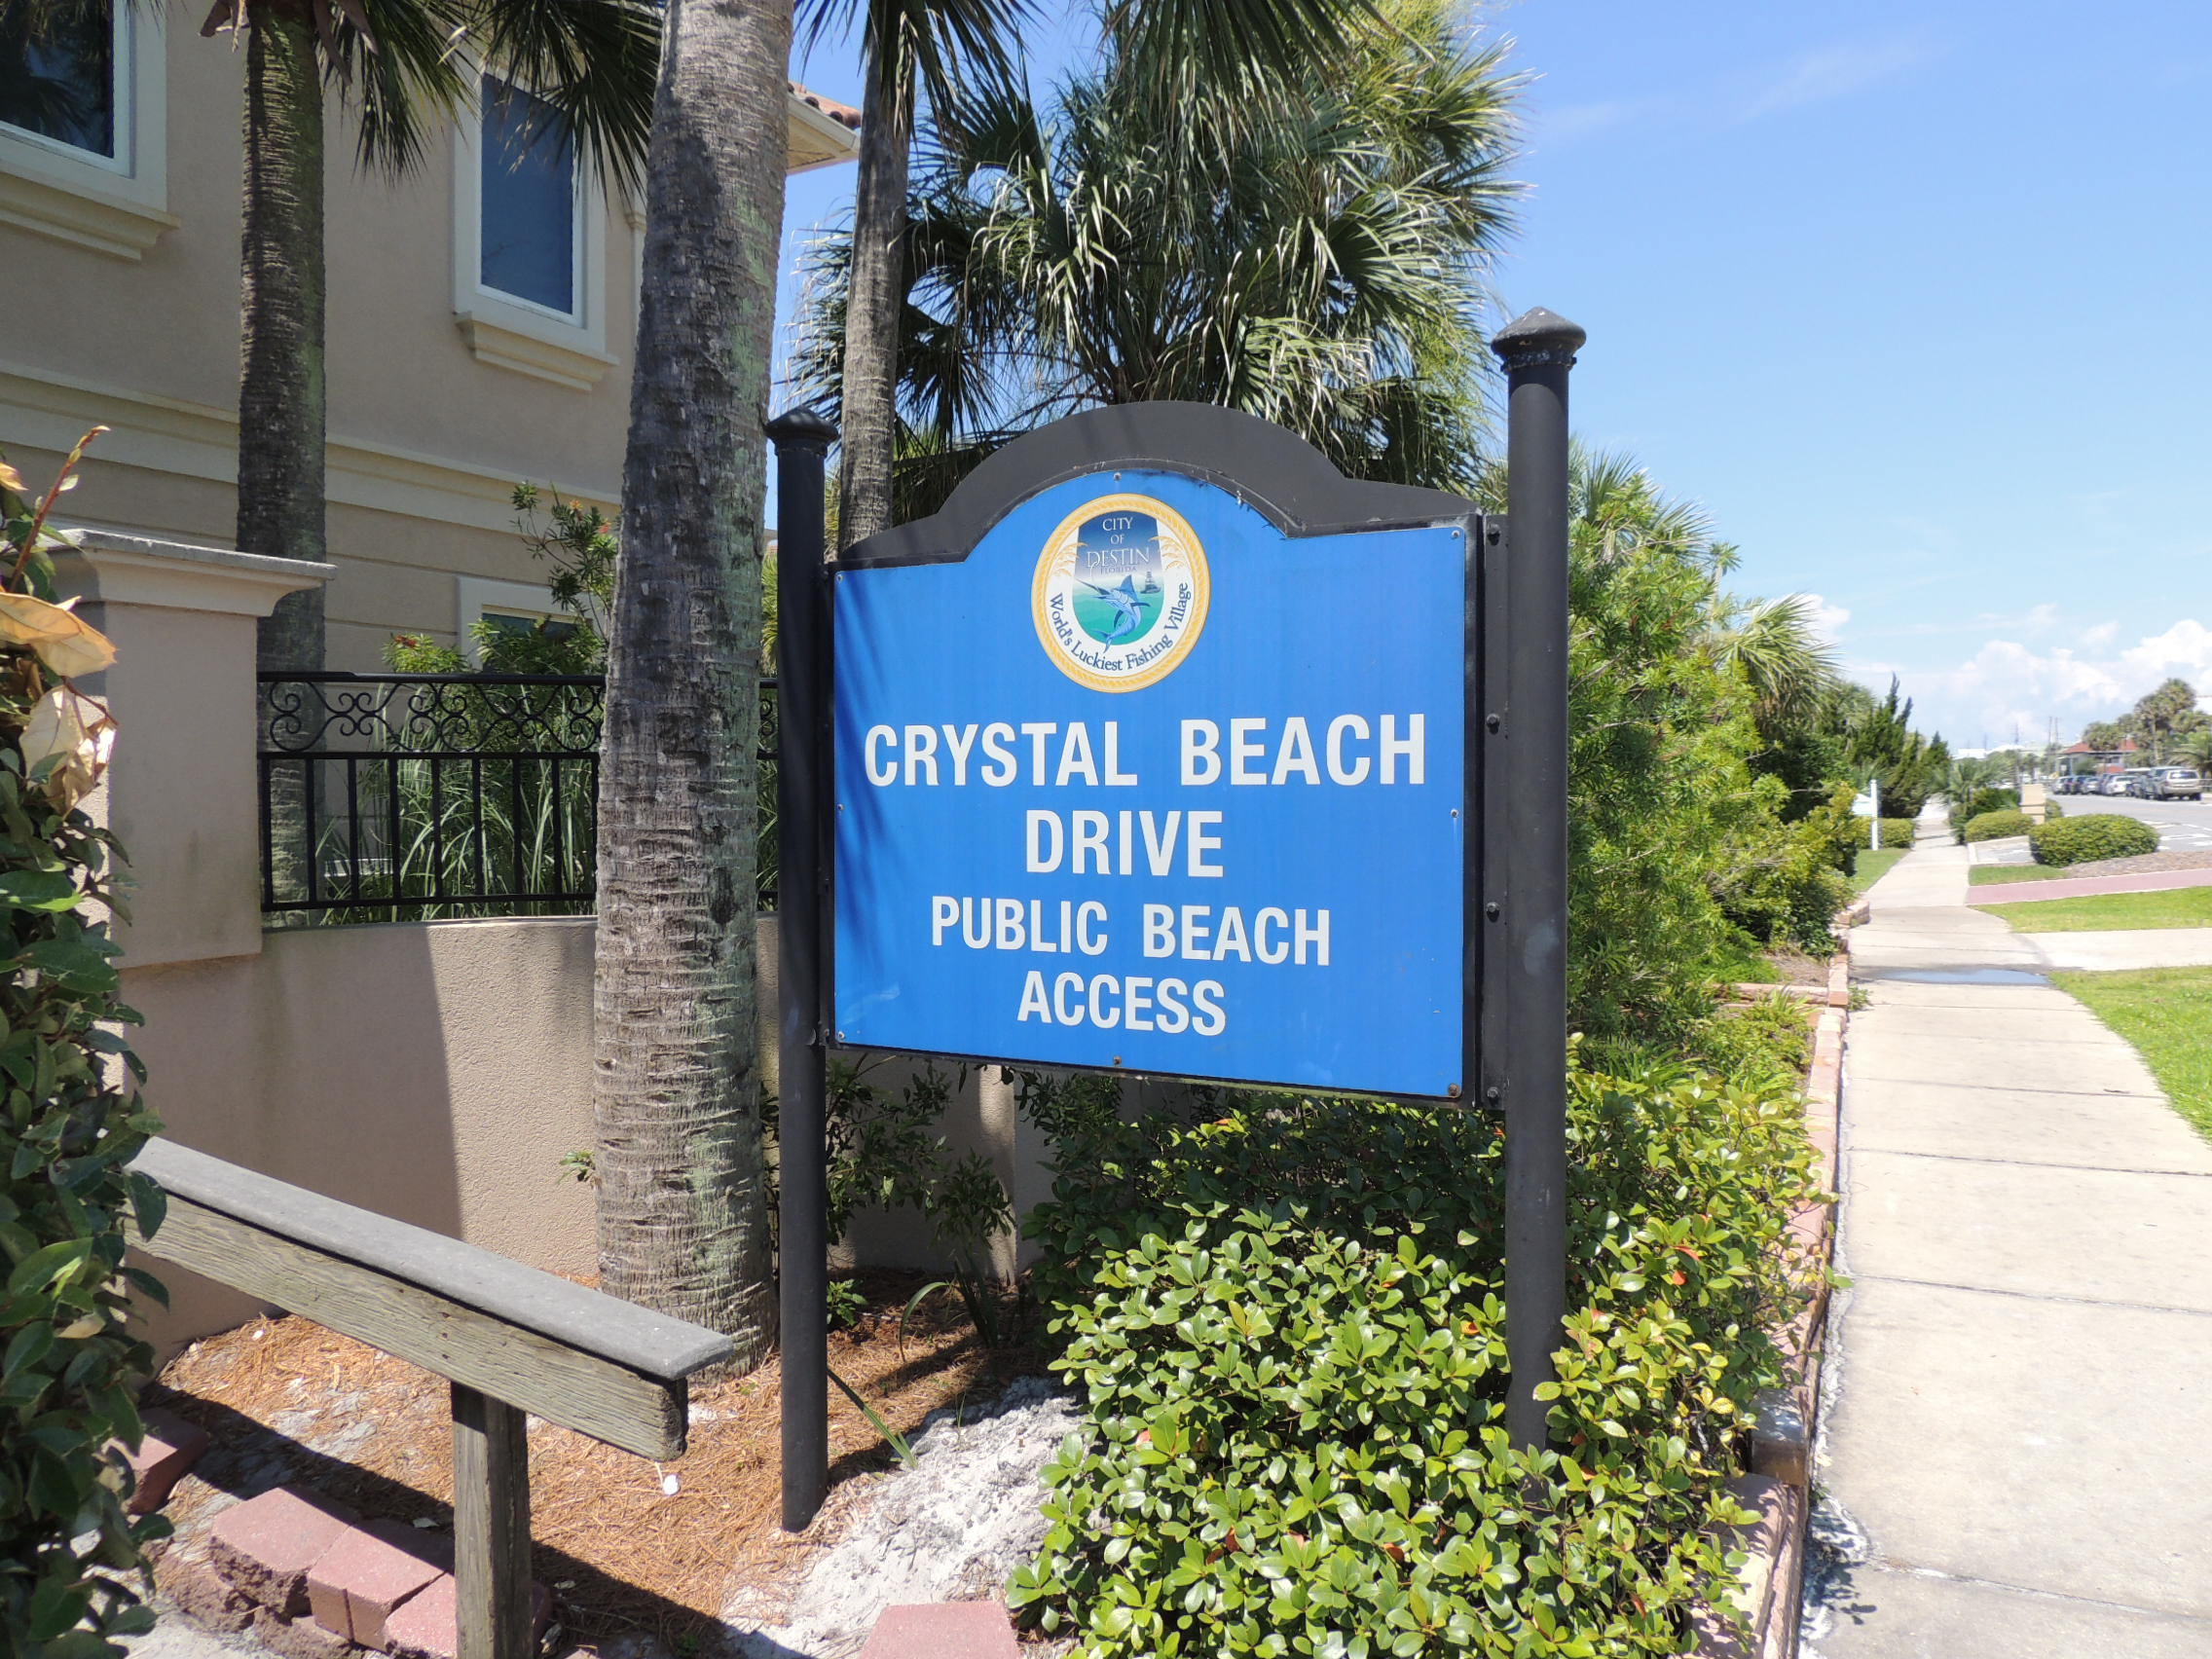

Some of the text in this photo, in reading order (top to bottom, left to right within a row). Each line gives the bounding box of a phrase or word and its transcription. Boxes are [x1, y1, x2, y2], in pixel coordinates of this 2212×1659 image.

[1087, 547, 1150, 569] DESTIN
[1102, 517, 1134, 532] CITY
[1110, 534, 1124, 545] OF
[1050, 581, 1192, 671] World's Luckiest Fishing Village
[865, 713, 1426, 788] CRYSTAL BEACH
[1026, 809, 1225, 878] DRIVE
[932, 895, 1330, 967] PUBLIC BEACH
[1017, 970, 1227, 1037] ACCESS
